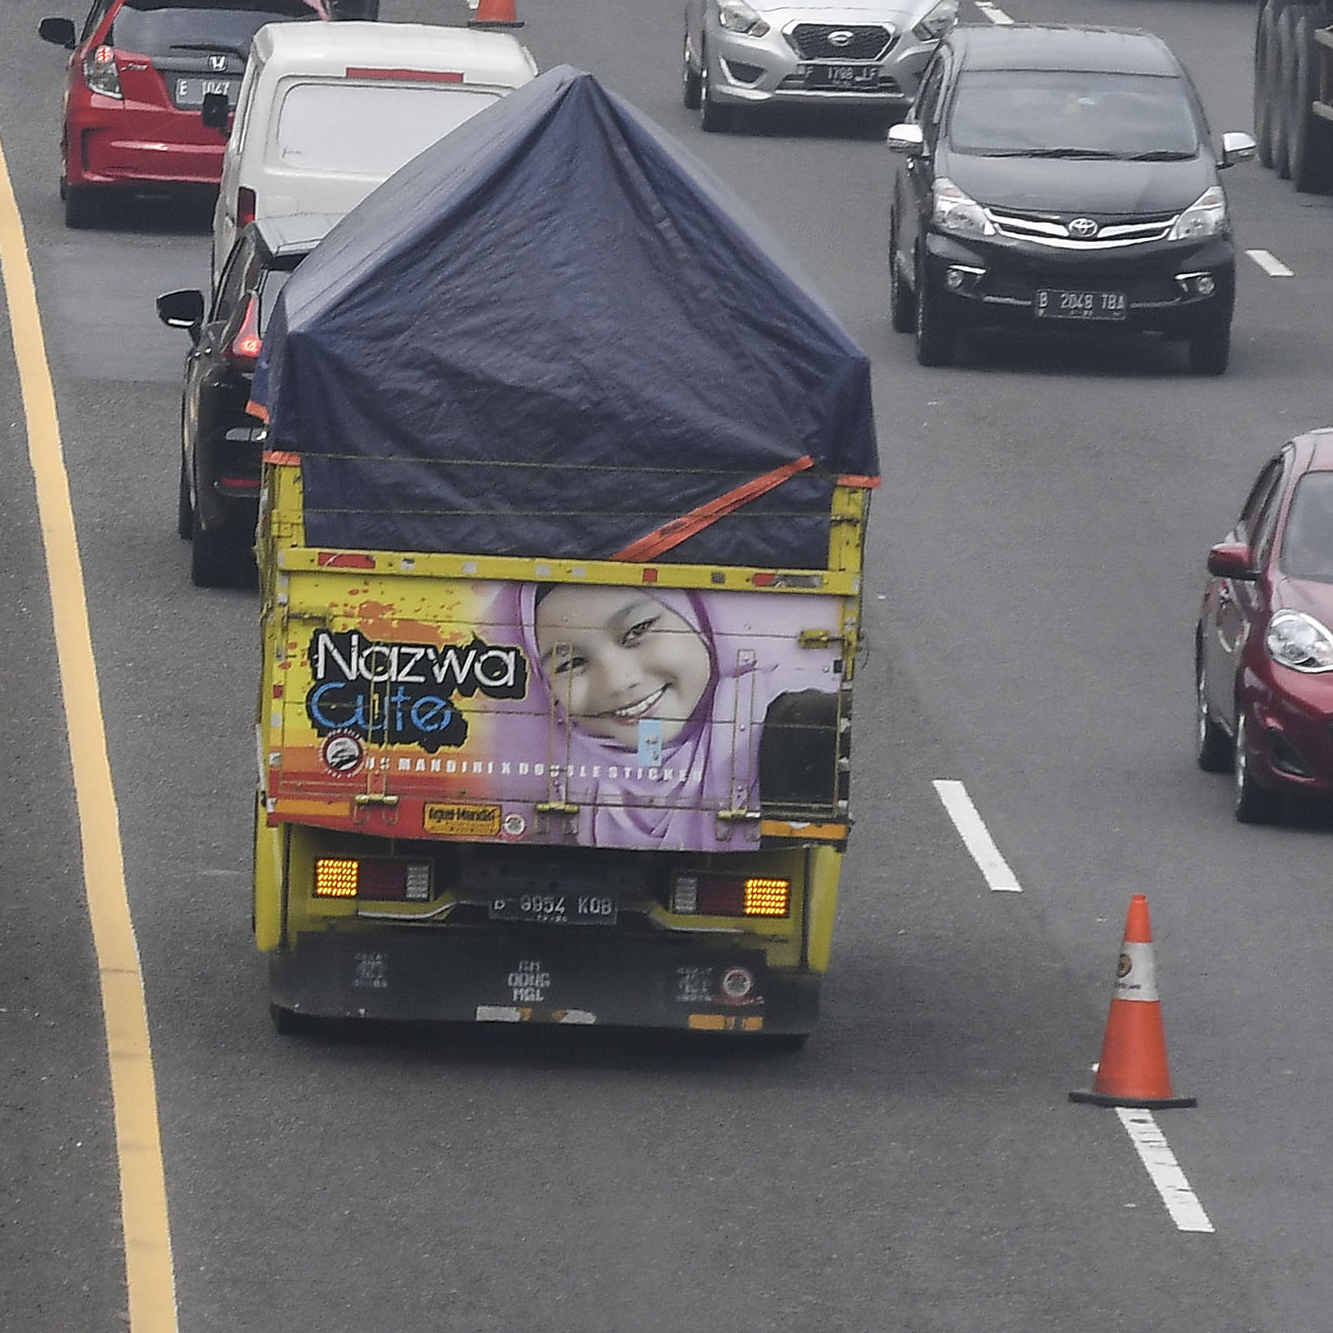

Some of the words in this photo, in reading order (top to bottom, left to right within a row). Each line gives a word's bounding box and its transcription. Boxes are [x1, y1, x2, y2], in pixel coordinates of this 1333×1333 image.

[179, 80, 188, 96] E
[313, 632, 516, 687] Nazwa
[310, 681, 453, 733] Cute
